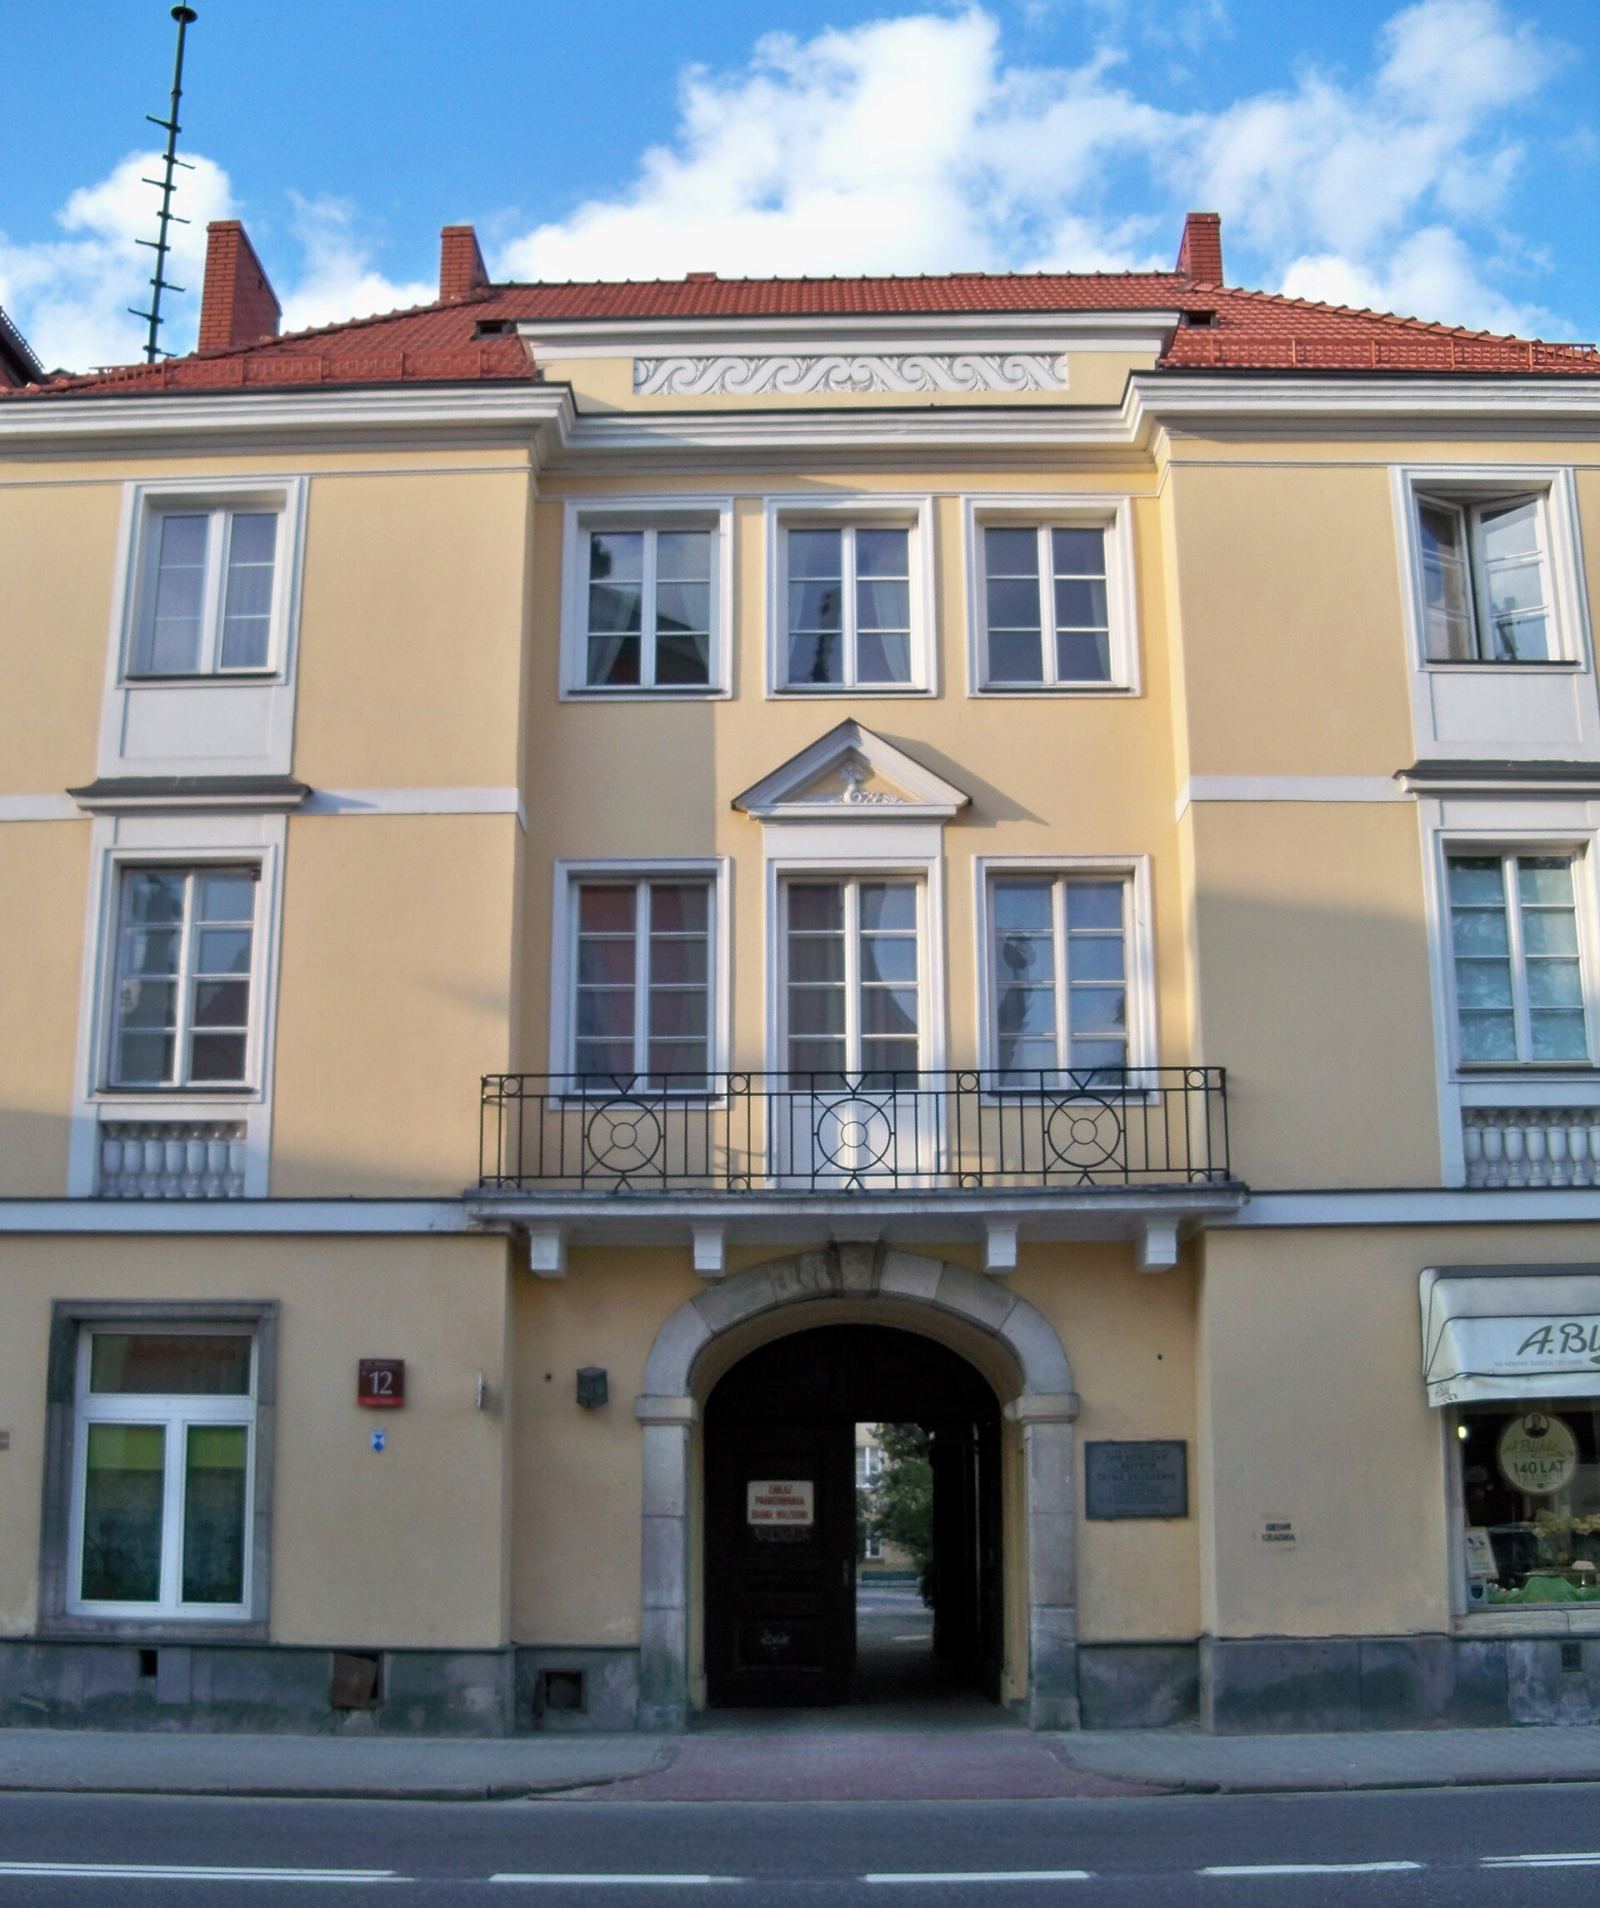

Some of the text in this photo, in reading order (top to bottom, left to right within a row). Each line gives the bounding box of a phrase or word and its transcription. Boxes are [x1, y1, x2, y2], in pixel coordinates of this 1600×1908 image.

[368, 1371, 393, 1394] 12
[1513, 1459, 1566, 1475] 140 LAT
